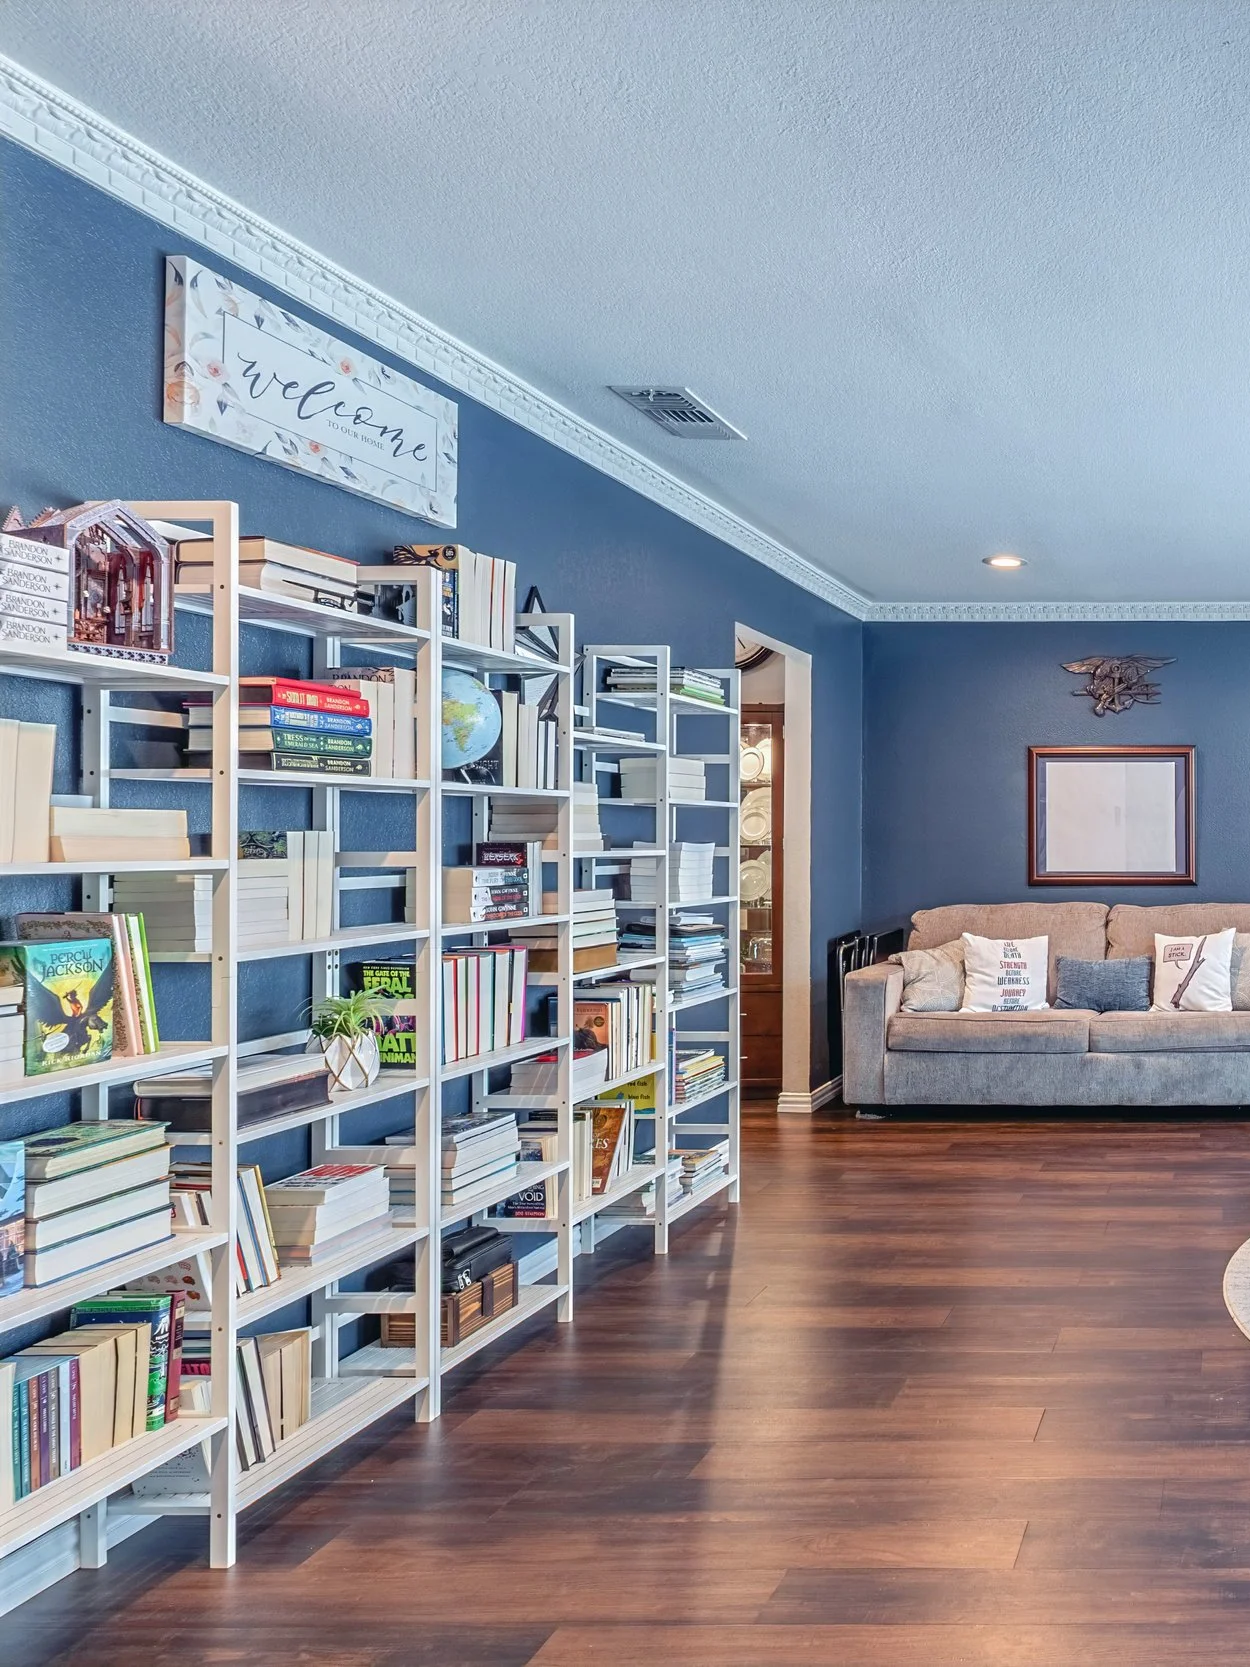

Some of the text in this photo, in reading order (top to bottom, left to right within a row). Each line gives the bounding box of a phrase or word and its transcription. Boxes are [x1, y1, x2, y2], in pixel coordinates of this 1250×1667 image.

[237, 352, 428, 462] welcome
[326, 419, 385, 451] TO OUR HOME
[8, 540, 48, 556] BRANDON
[4, 548, 53, 565] SANDERSON
[7, 568, 47, 584] BRANDON
[2, 576, 51, 593] SANDERSON
[6, 594, 45, 609] BRANDON
[1, 602, 49, 618] SANDERSON
[1, 629, 51, 643] SANDERSON
[6, 621, 46, 635] BRANDON
[283, 733, 304, 742] TRESS
[50, 948, 93, 965] PERCY
[1000, 960, 1027, 969] STRENGTH
[40, 958, 104, 983] JACKSON
[363, 969, 375, 977] THE
[399, 970, 411, 978] THE
[363, 976, 412, 993] FERAL
[997, 976, 1030, 985] WEAKNESS
[376, 1032, 416, 1052] ATT
[41, 1050, 102, 1067] RICK RIORDAN
[518, 1191, 544, 1202] VOID
